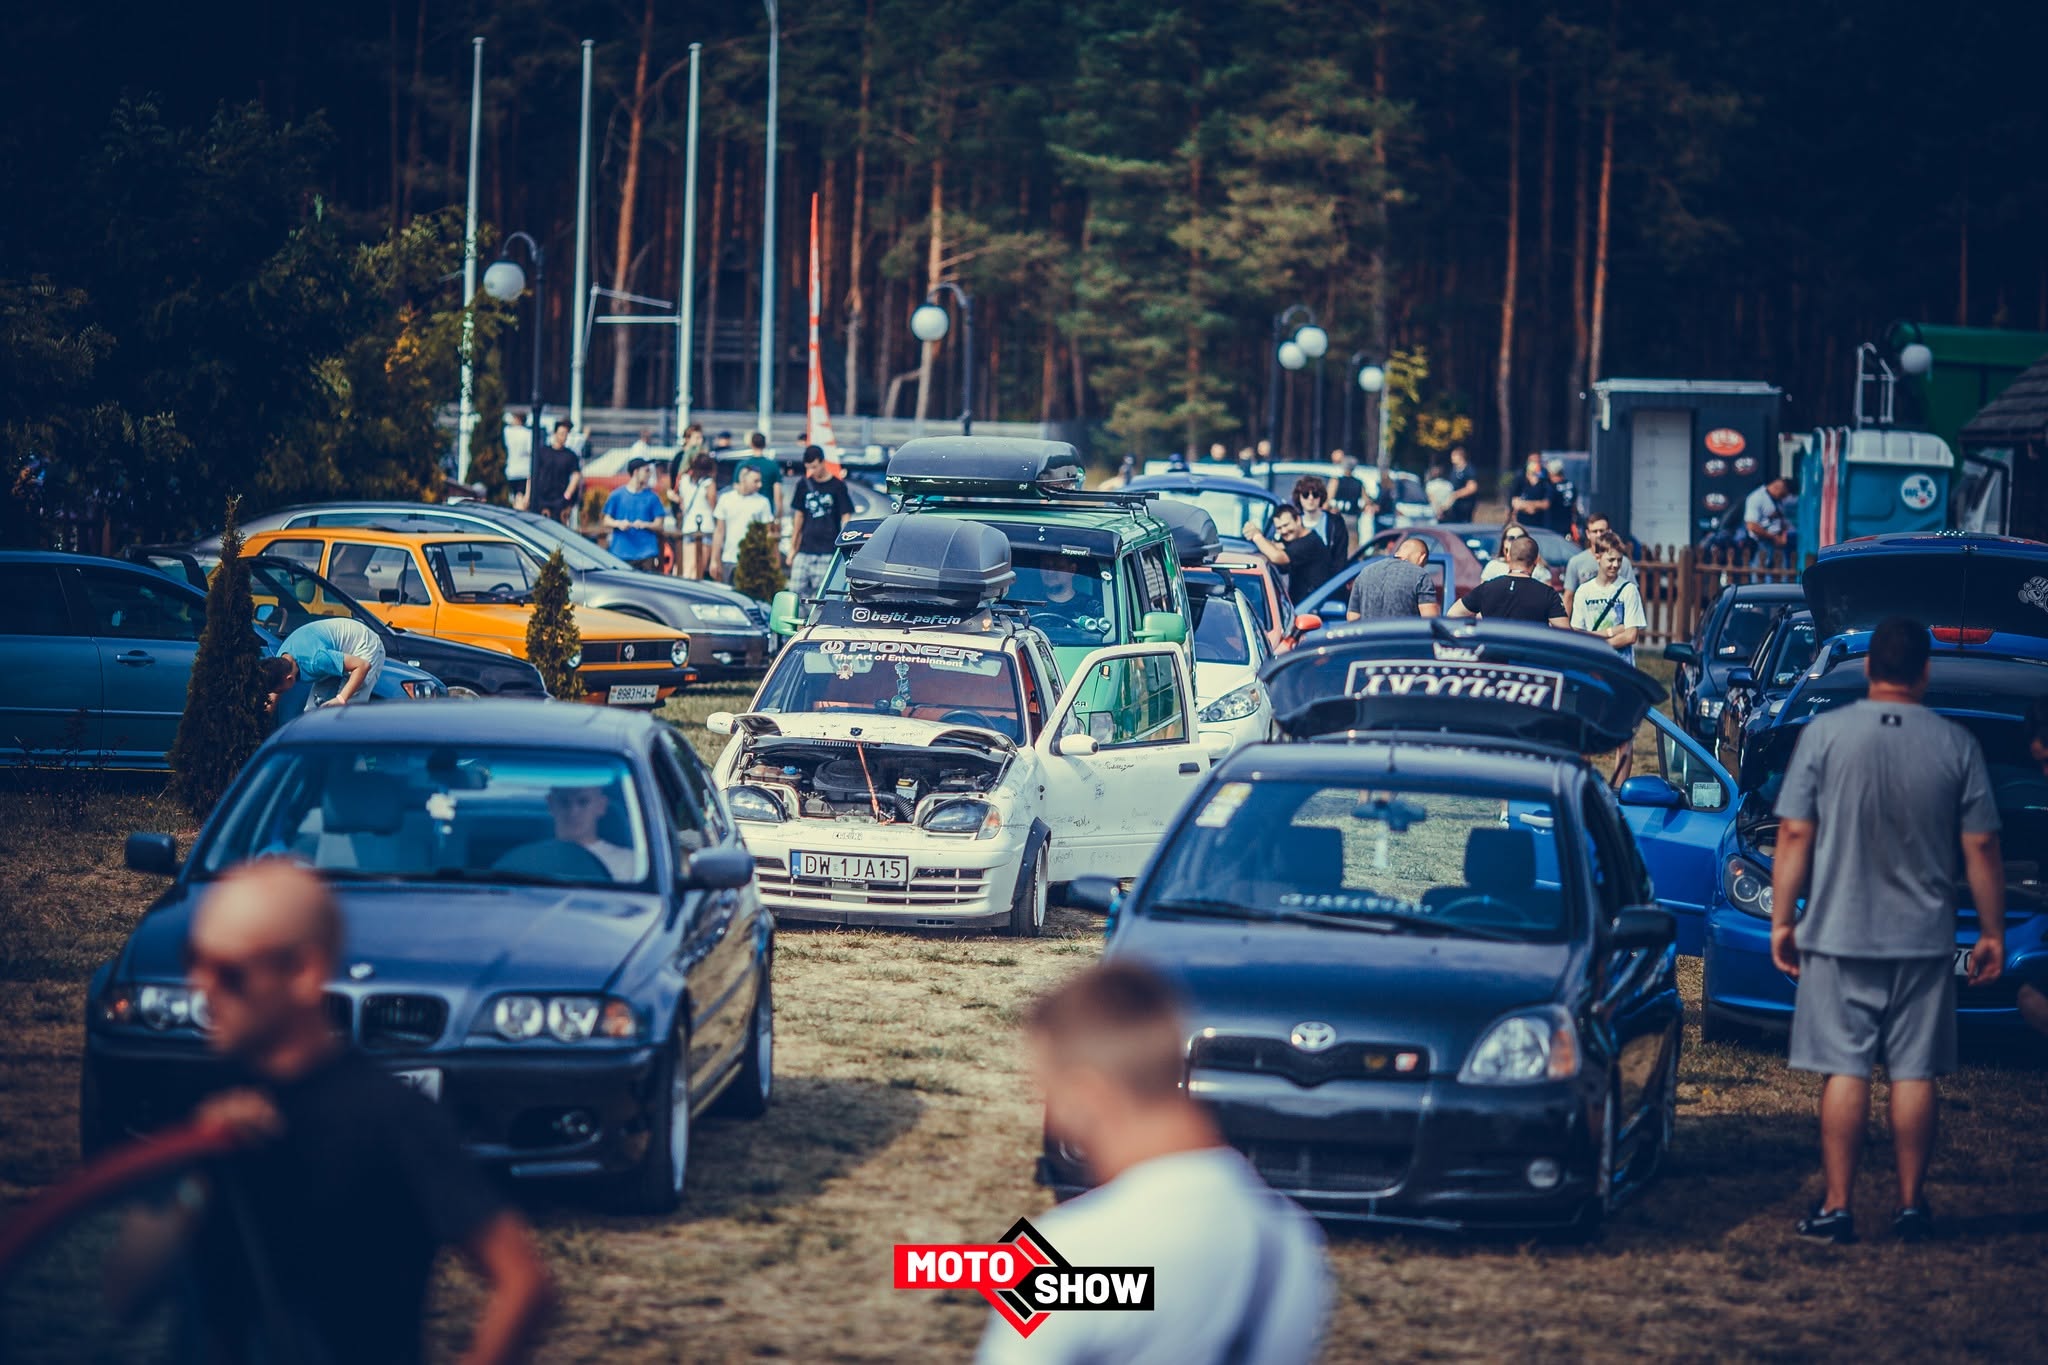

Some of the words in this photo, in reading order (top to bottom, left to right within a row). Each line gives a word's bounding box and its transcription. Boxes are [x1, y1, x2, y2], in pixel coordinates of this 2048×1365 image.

[834, 653, 853, 661] The
[855, 653, 873, 661] Art
[874, 653, 887, 661] of
[888, 654, 963, 668] Entertainment
[850, 641, 983, 662] PIONEER
[805, 855, 831, 876] DW
[841, 858, 901, 879] 1JA15
